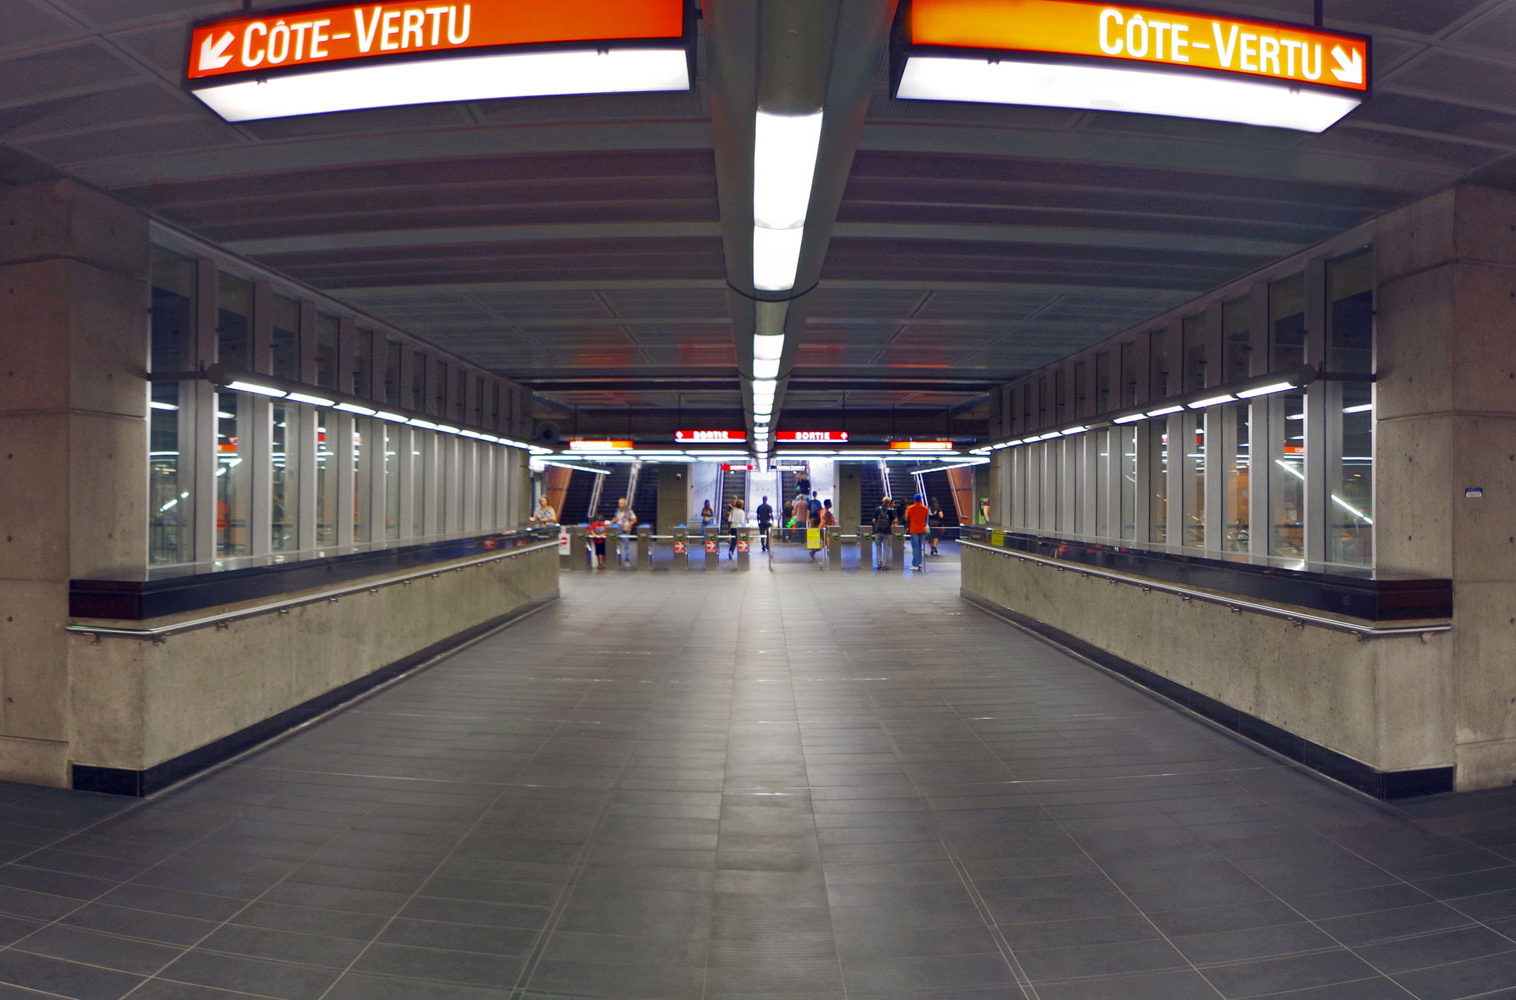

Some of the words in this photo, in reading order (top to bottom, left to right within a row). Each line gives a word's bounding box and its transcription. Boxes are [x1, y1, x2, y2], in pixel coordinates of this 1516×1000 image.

[241, 5, 471, 67] CÔTE-VERTU
[1099, 8, 1322, 80] CÔTE-VERTU
[693, 431, 729, 440] SORTIE
[795, 432, 830, 440] SORTIE
